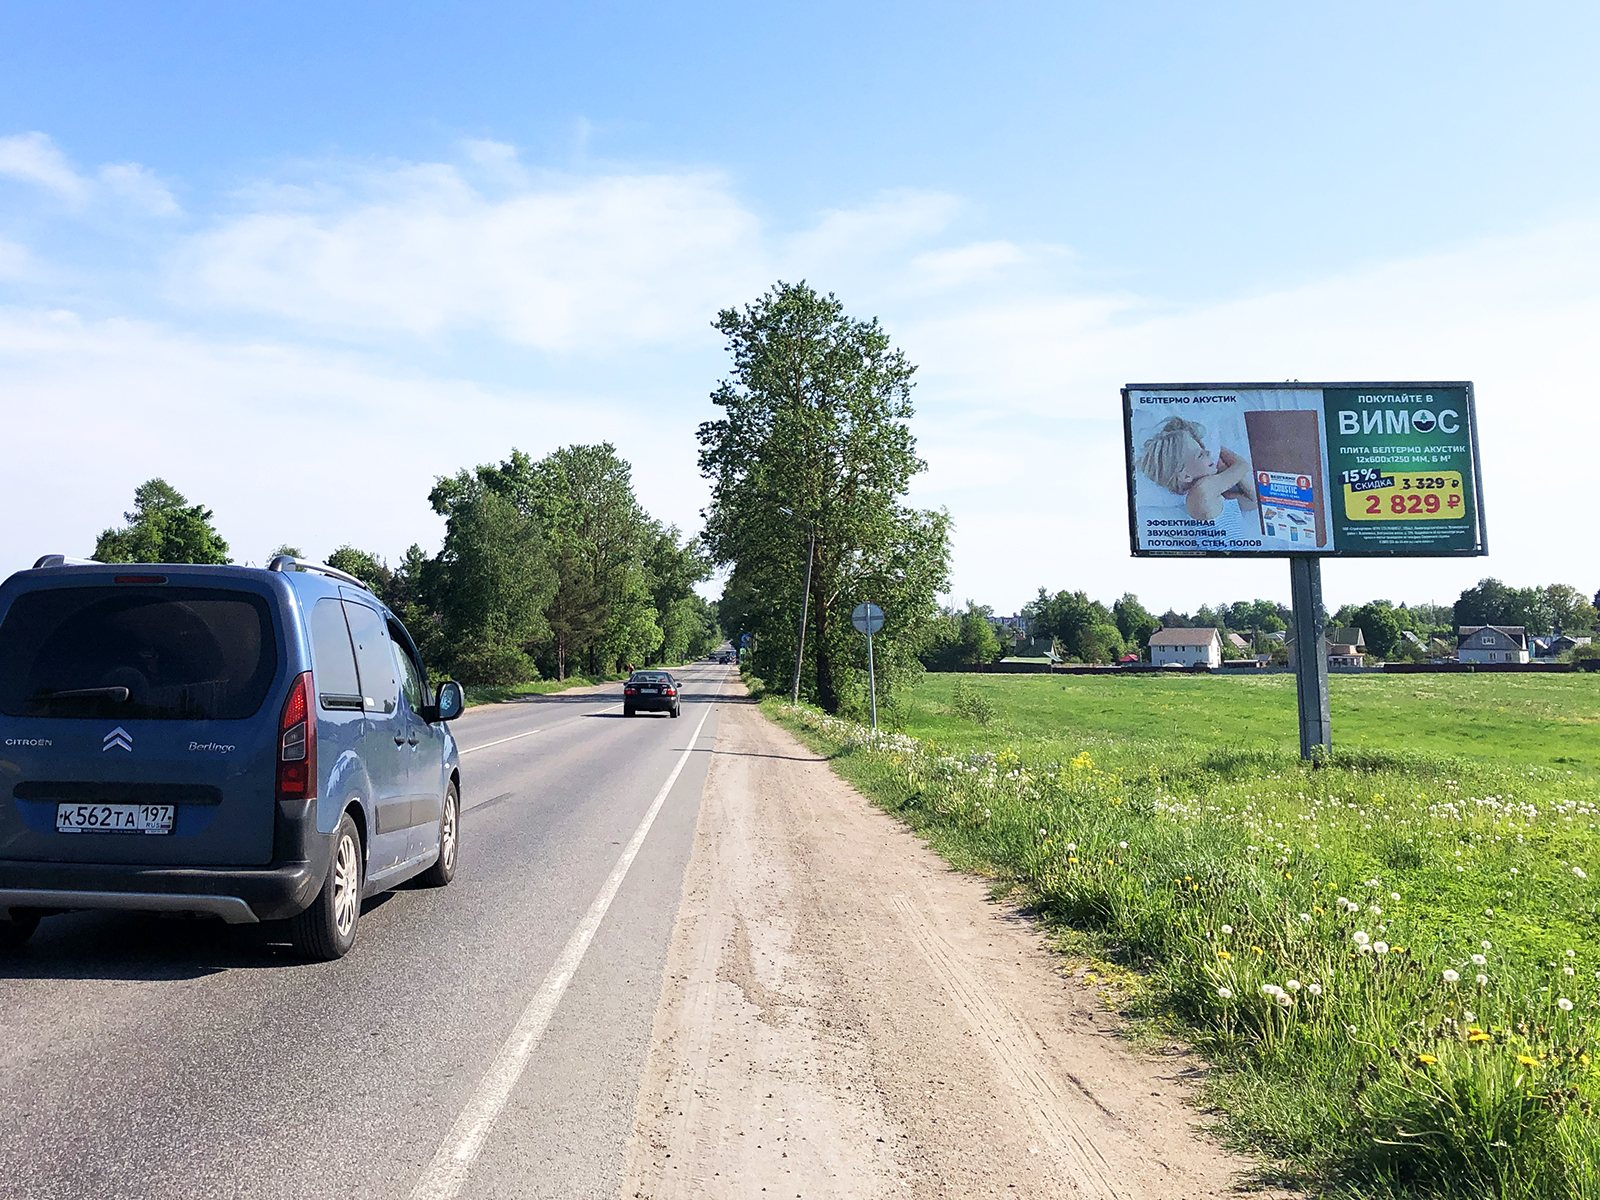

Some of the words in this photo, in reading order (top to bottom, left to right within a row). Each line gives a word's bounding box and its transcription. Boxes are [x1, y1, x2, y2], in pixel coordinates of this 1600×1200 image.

[1140, 396, 1190, 404] БЕЛТЕРМО
[1358, 394, 1422, 403] ПОКУПАЙТЕ
[1426, 395, 1433, 403] В
[1338, 409, 1460, 435] ВИМОС
[1342, 468, 1377, 483] 15%
[1355, 477, 1393, 490] СКИДКА
[1402, 479, 1411, 489] 3
[1416, 478, 1445, 489] 329
[1366, 494, 1381, 514] 2
[1390, 494, 1440, 514] 829
[5, 738, 52, 746] CITROËN
[189, 742, 236, 753] Berlingo
[142, 807, 169, 821] 197
